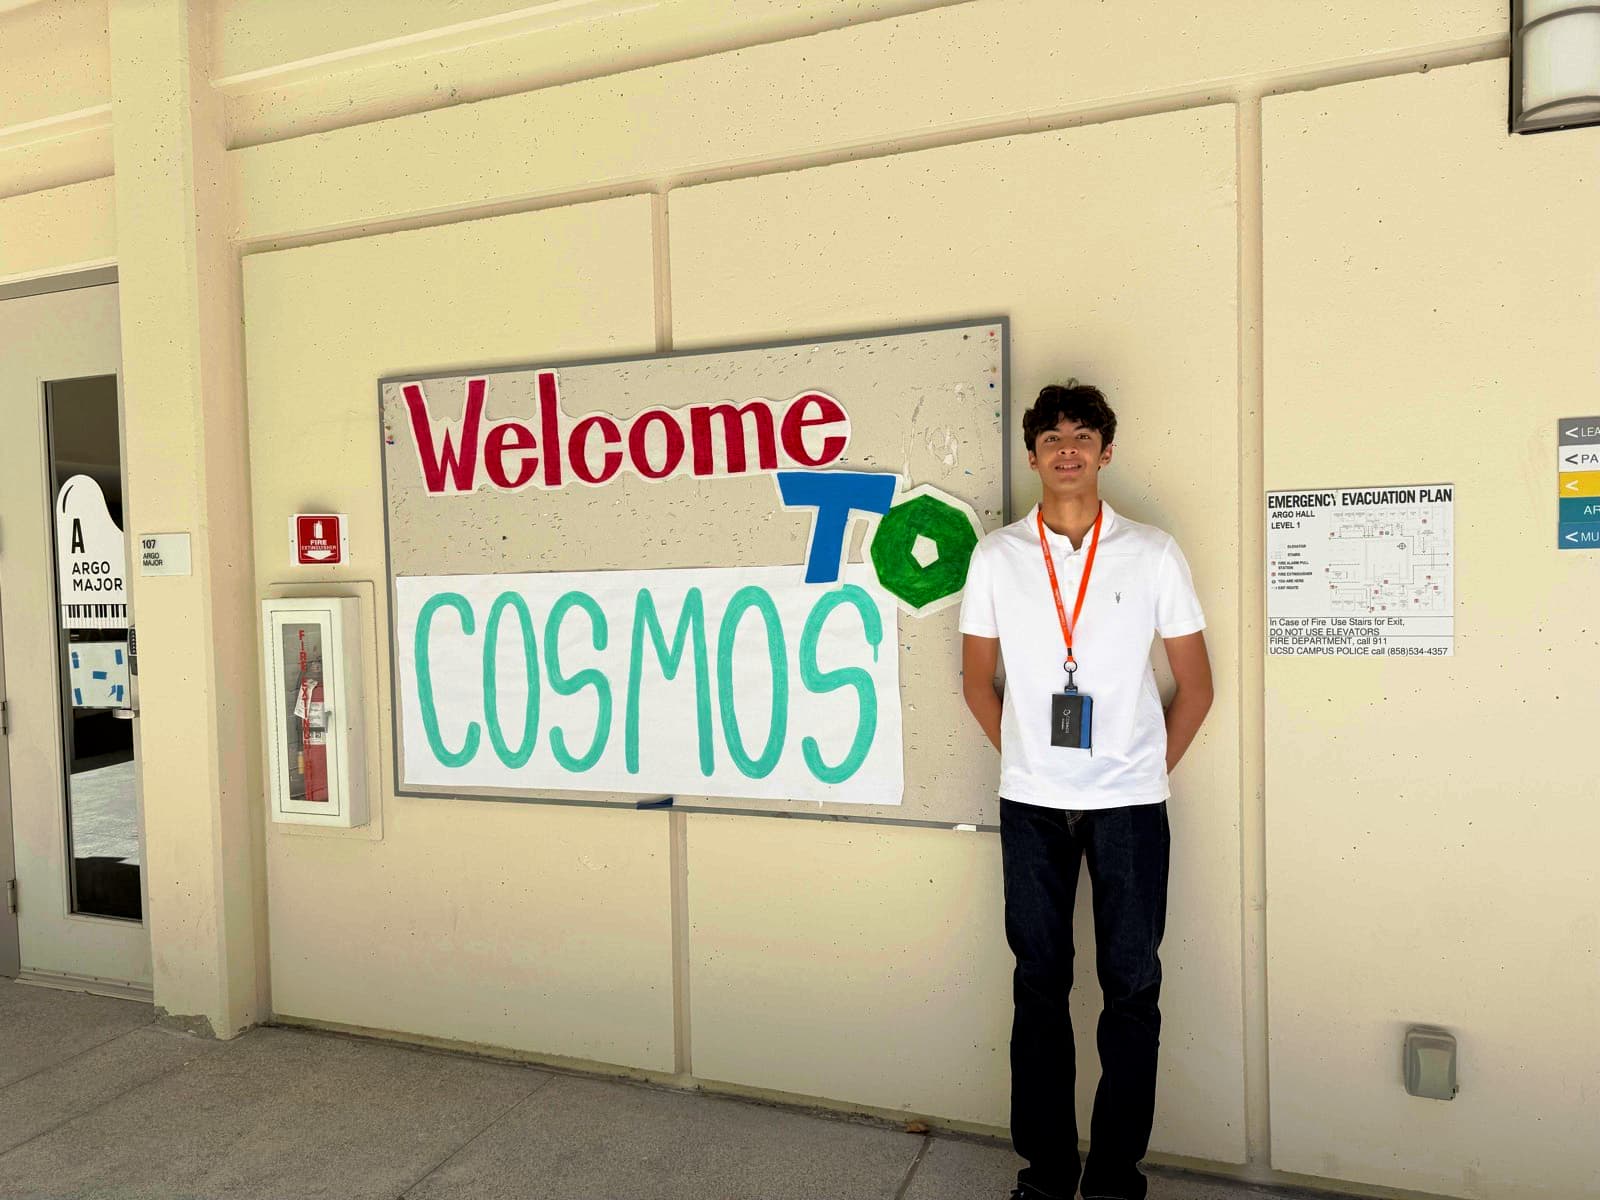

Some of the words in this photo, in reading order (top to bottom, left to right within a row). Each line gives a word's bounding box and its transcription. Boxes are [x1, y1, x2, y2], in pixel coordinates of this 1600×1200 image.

[402, 372, 847, 493] Welcome
[1268, 493, 1337, 508] EMERGENCY
[1342, 490, 1416, 506] EVACUATION
[1419, 488, 1452, 503] PLAN
[1272, 511, 1294, 519] ARGO
[1295, 510, 1316, 518] HALL
[1271, 522, 1295, 530] LEVEL
[1297, 521, 1301, 529] 1
[71, 518, 85, 554] A
[776, 471, 979, 610] TO
[142, 539, 156, 549] 107
[72, 561, 111, 575] ARGO
[143, 559, 163, 567] MAJOR
[73, 578, 123, 592] MAJOR
[1270, 618, 1277, 626] In
[1279, 618, 1299, 626] Case
[1301, 618, 1309, 626] of
[1311, 618, 1326, 626] Fire
[1331, 618, 1347, 626] Use
[1348, 618, 1372, 626] Stairs
[1374, 618, 1385, 626] for
[1387, 618, 1405, 626] Exit,
[1270, 628, 1283, 636] DO
[1285, 628, 1303, 636] NOT
[1305, 628, 1324, 636] USE
[1326, 628, 1380, 636] ELEVATORS
[1270, 637, 1289, 645] FIRE
[1292, 637, 1355, 645] DEPARTMENT,
[1356, 637, 1371, 645] call
[1372, 637, 1387, 645] 911
[298, 629, 307, 673] FIRE
[1270, 647, 1294, 655] UCSD
[1296, 647, 1334, 655] CAMPUS
[1336, 647, 1369, 655] POLICE
[1371, 647, 1385, 655] call
[1387, 647, 1448, 656] (858)534-4357
[414, 584, 884, 784] COSMOS
